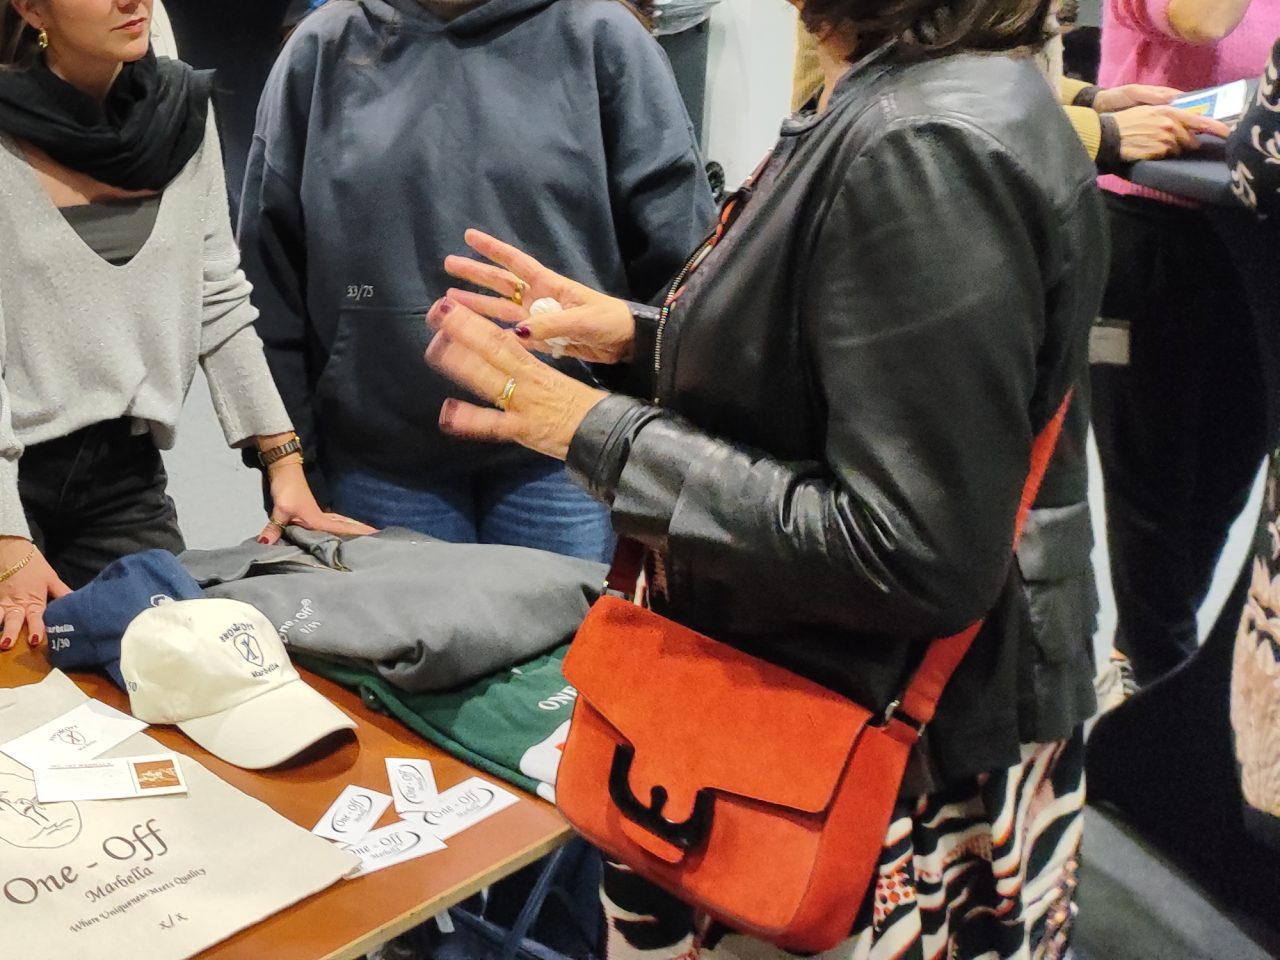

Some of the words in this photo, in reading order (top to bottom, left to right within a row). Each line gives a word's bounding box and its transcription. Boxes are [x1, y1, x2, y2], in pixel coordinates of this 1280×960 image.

[431, 805, 453, 819] One
[457, 790, 481, 805] Off
[379, 832, 404, 846] Off
[3, 864, 80, 905] One
[102, 818, 169, 862] Off
[84, 865, 155, 903] Marbella
